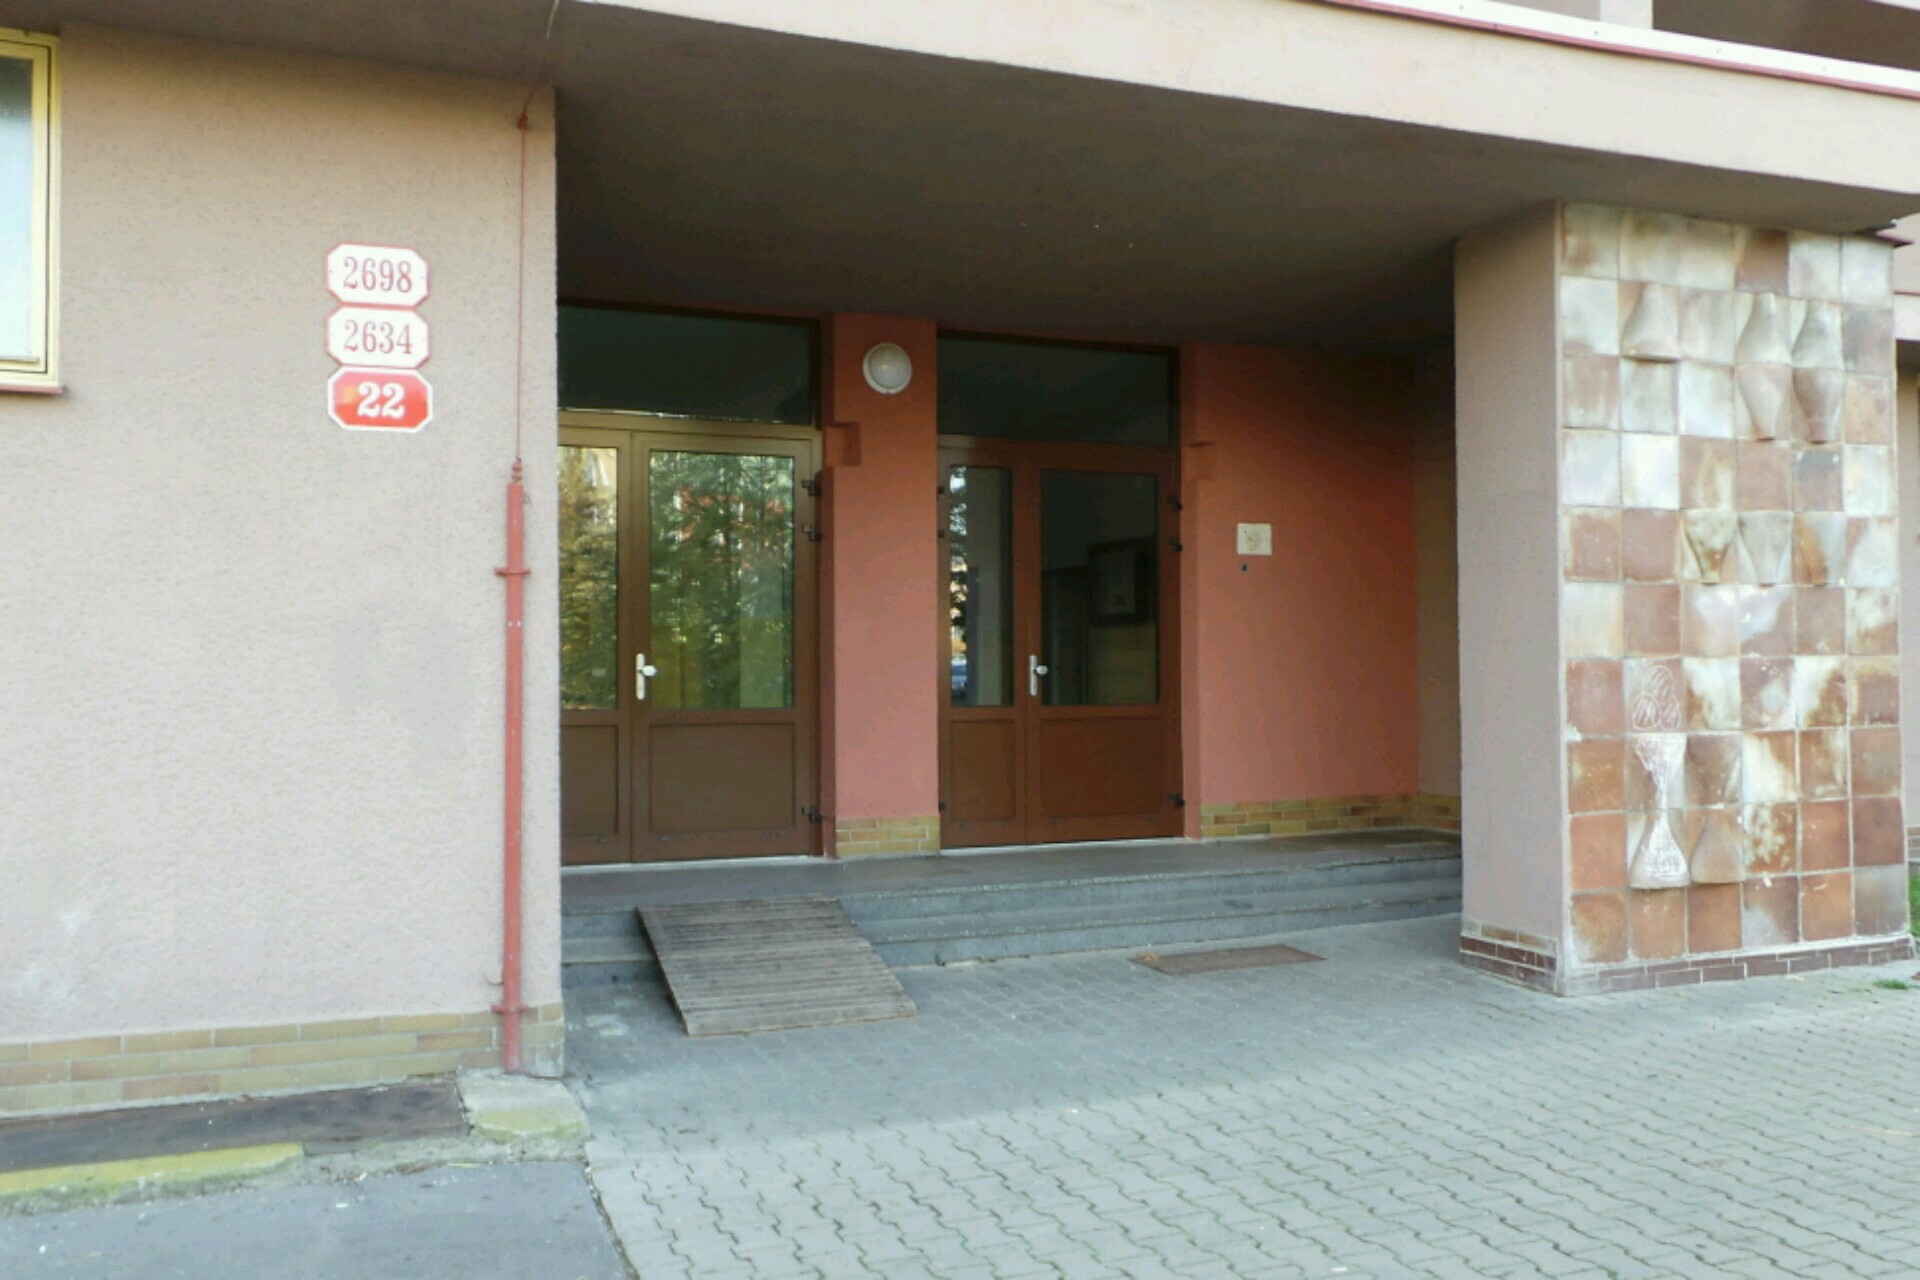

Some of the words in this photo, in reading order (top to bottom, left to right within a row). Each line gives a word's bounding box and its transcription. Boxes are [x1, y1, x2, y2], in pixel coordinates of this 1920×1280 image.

[343, 256, 412, 293] 2698
[343, 319, 412, 355] 2634
[356, 381, 405, 420] 22
